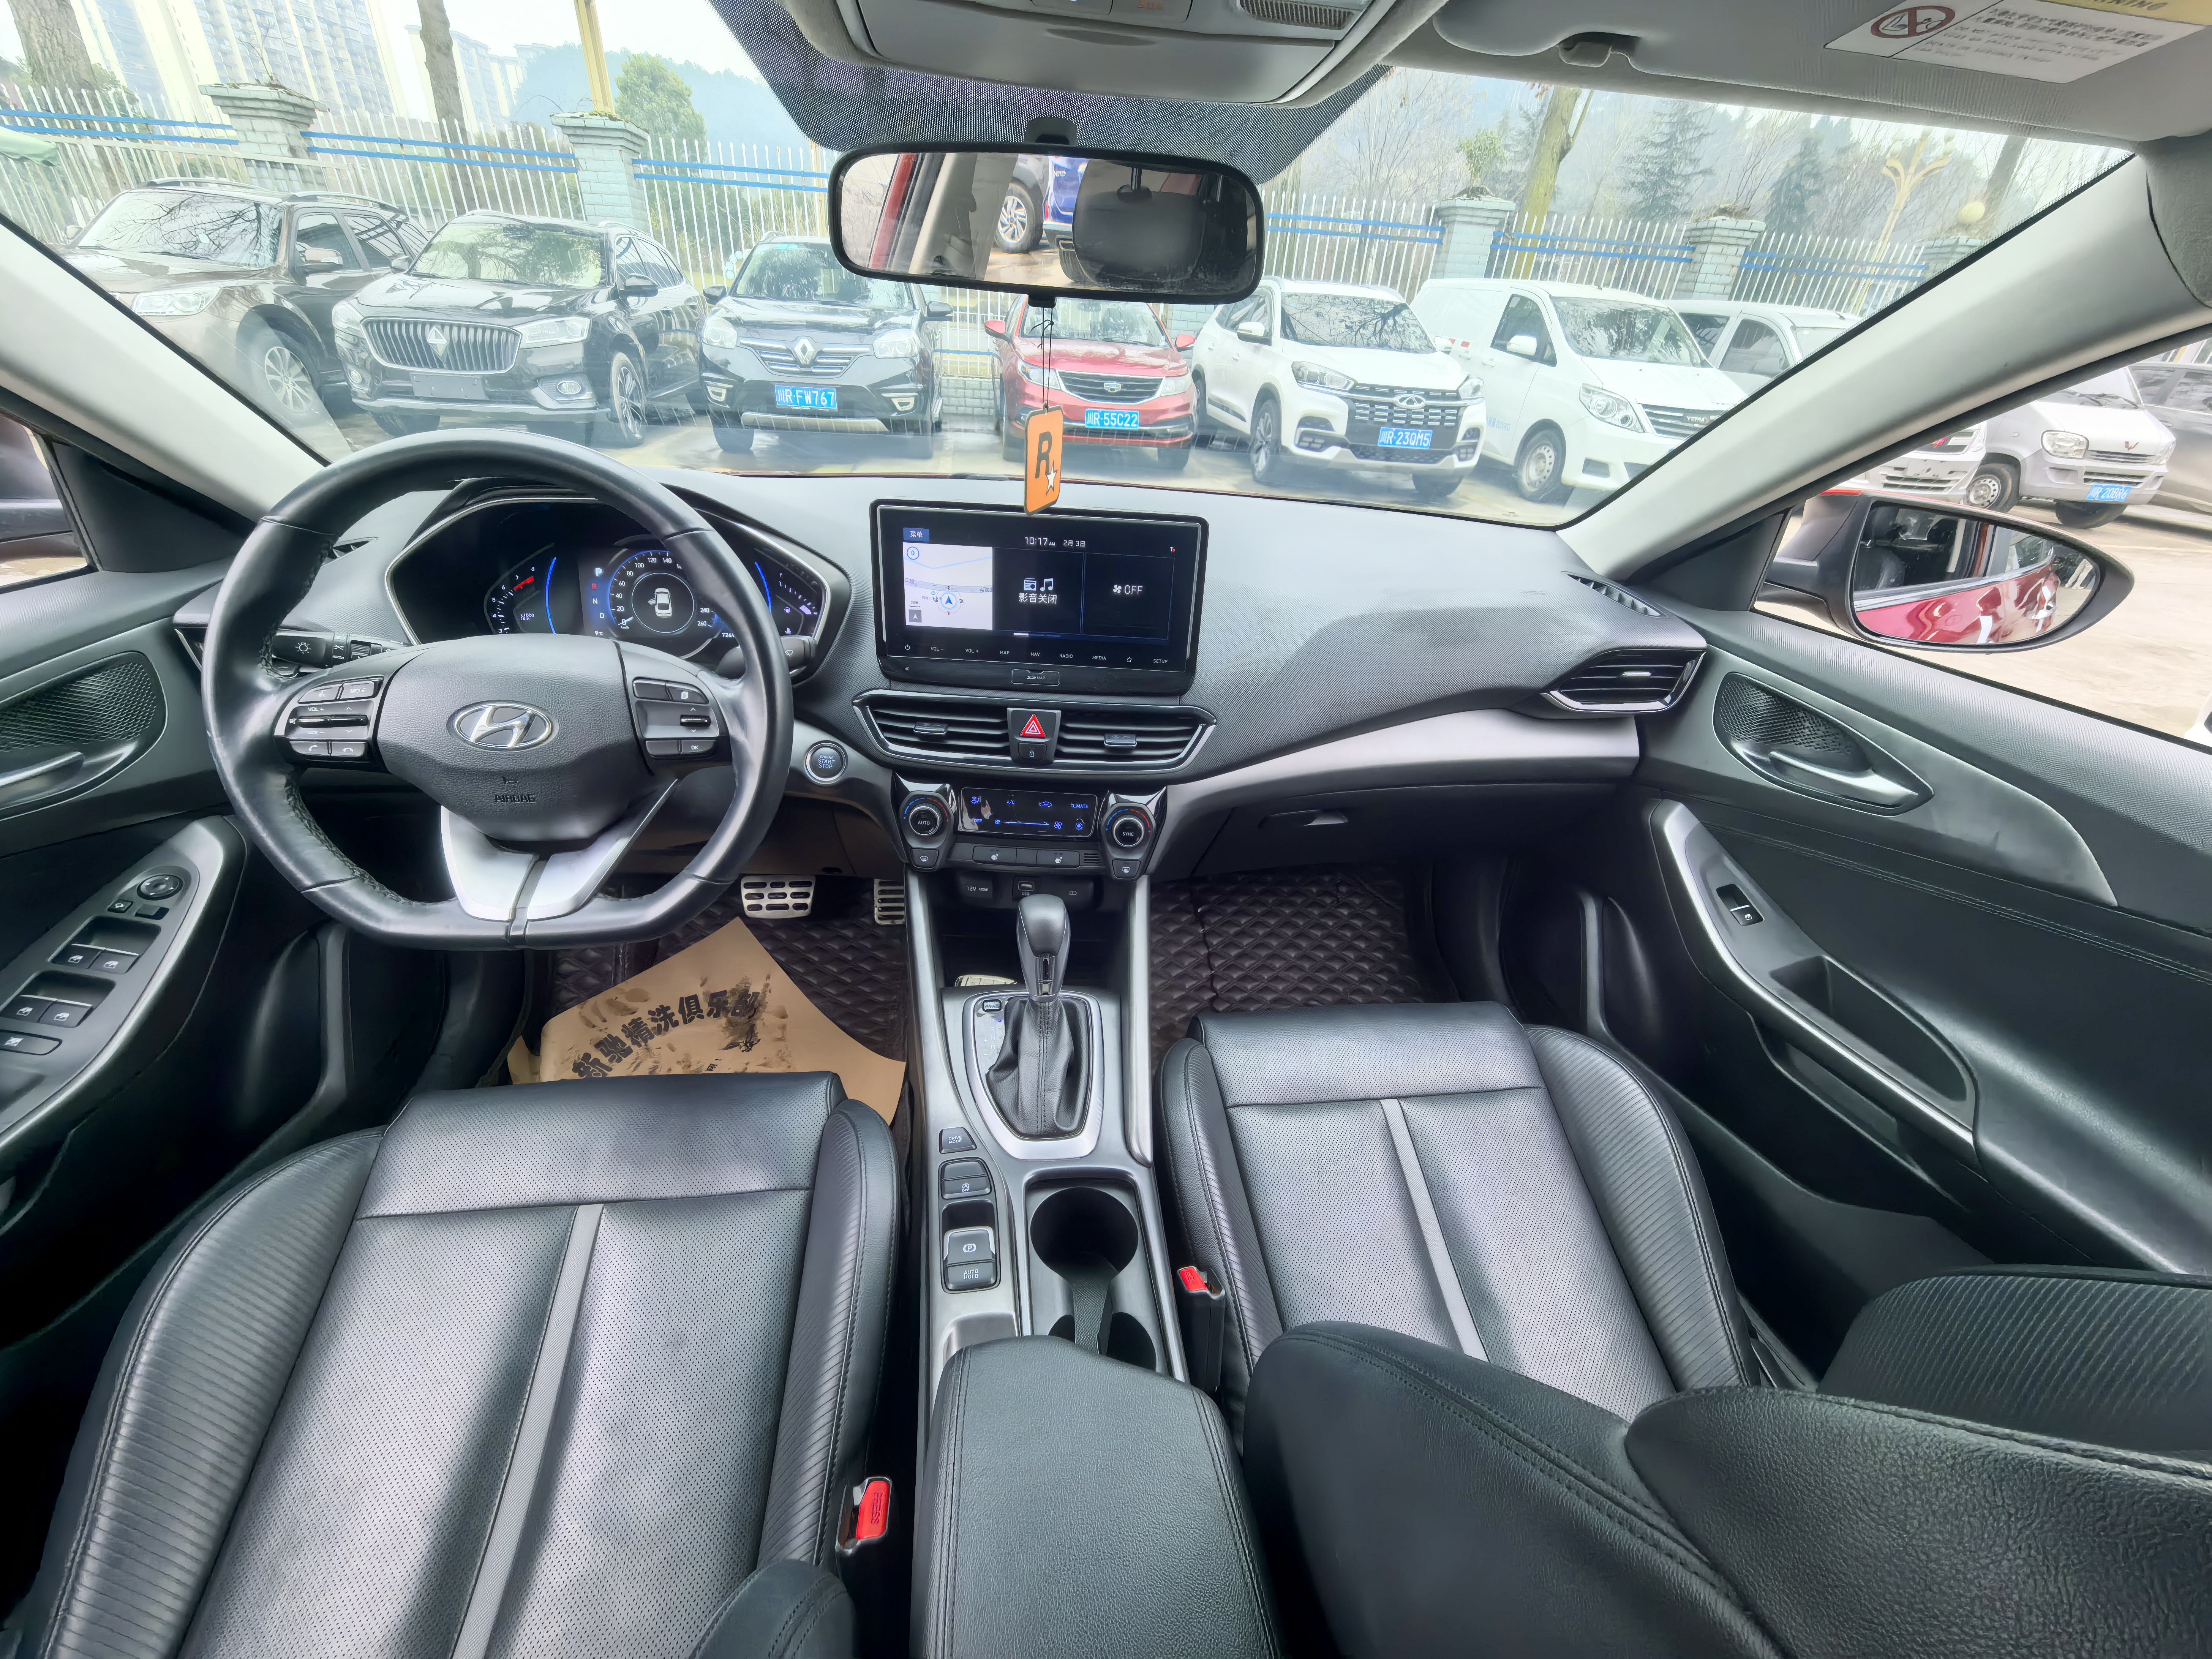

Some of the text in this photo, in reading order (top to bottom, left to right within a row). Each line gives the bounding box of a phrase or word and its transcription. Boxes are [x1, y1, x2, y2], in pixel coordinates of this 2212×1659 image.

[1025, 537, 1048, 545] 10:17
[595, 567, 602, 576] P
[1124, 585, 1143, 595] OFF
[1019, 592, 1057, 604] 影音关闭
